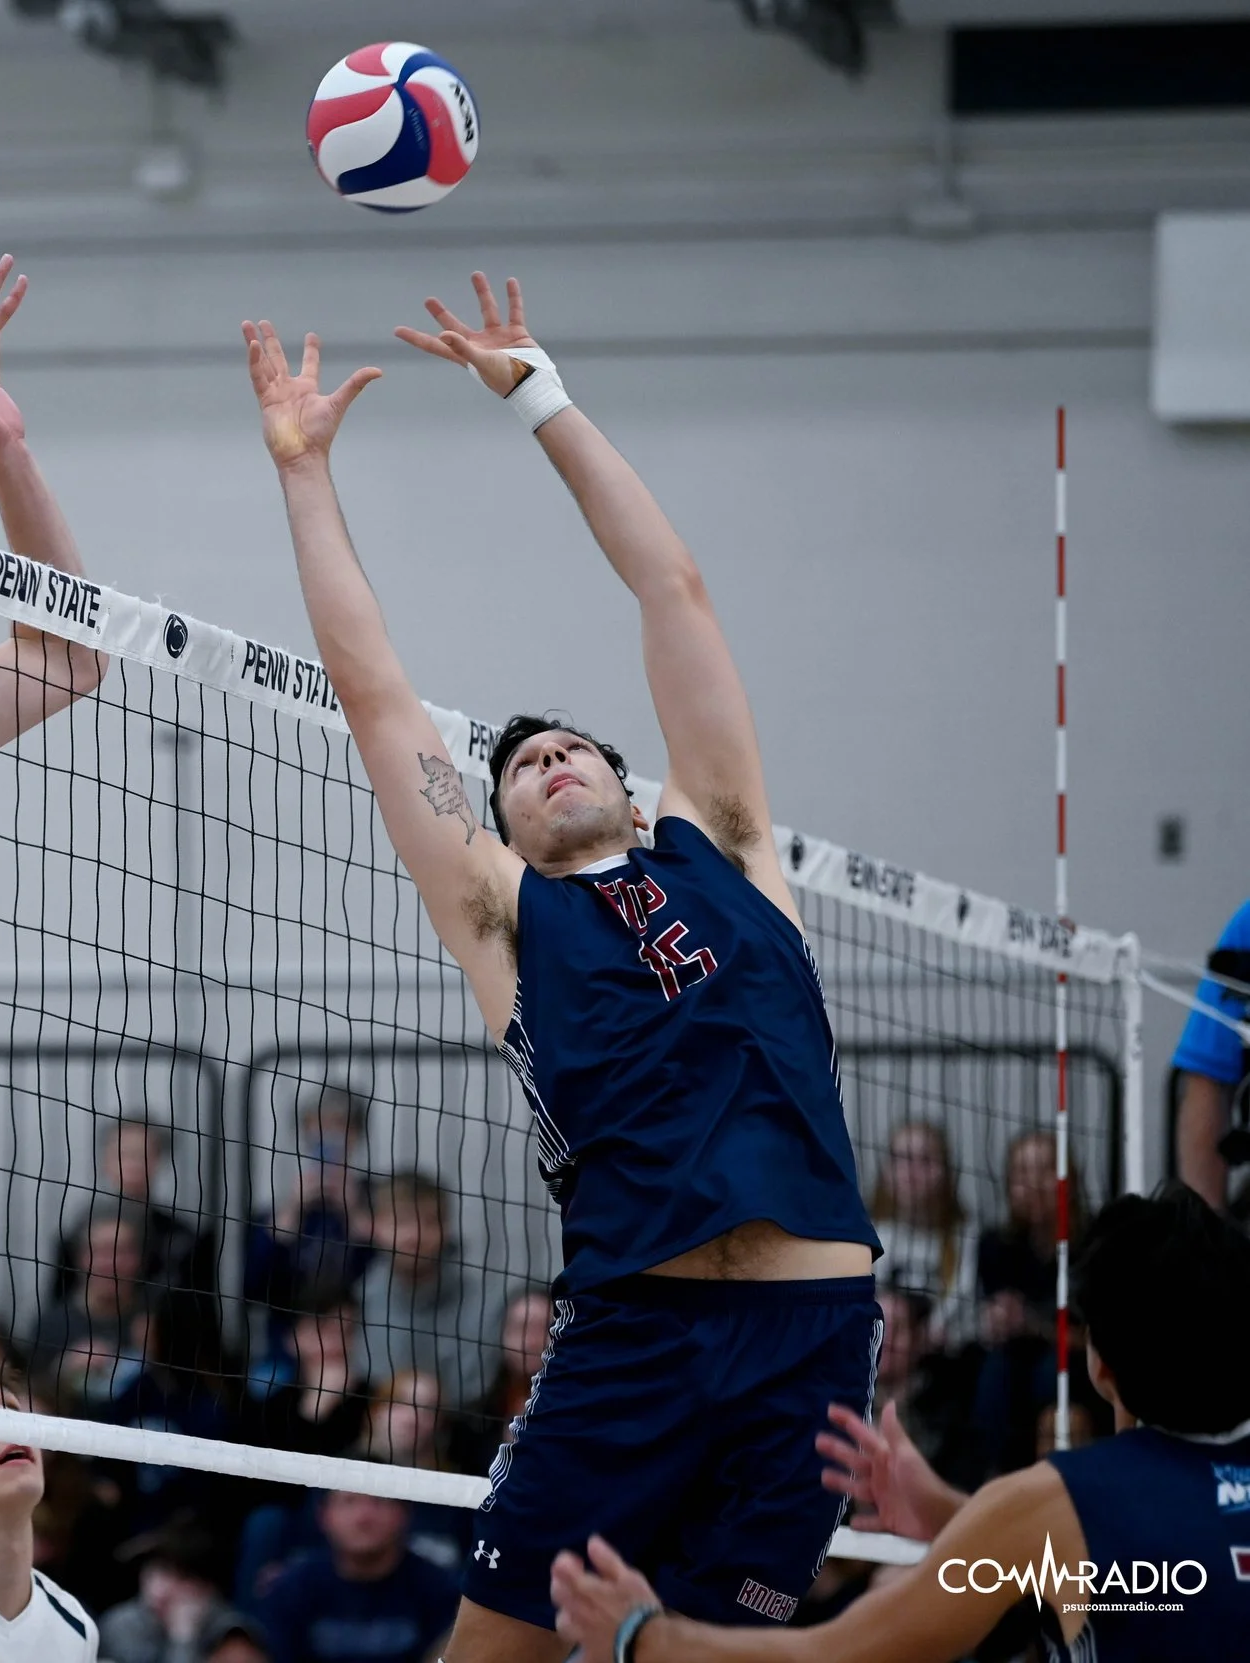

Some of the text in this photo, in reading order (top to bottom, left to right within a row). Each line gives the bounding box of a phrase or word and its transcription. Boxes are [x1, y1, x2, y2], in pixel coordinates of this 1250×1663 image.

[45, 569, 101, 629] STATE
[241, 640, 290, 694] PENN
[468, 720, 496, 762] PEN
